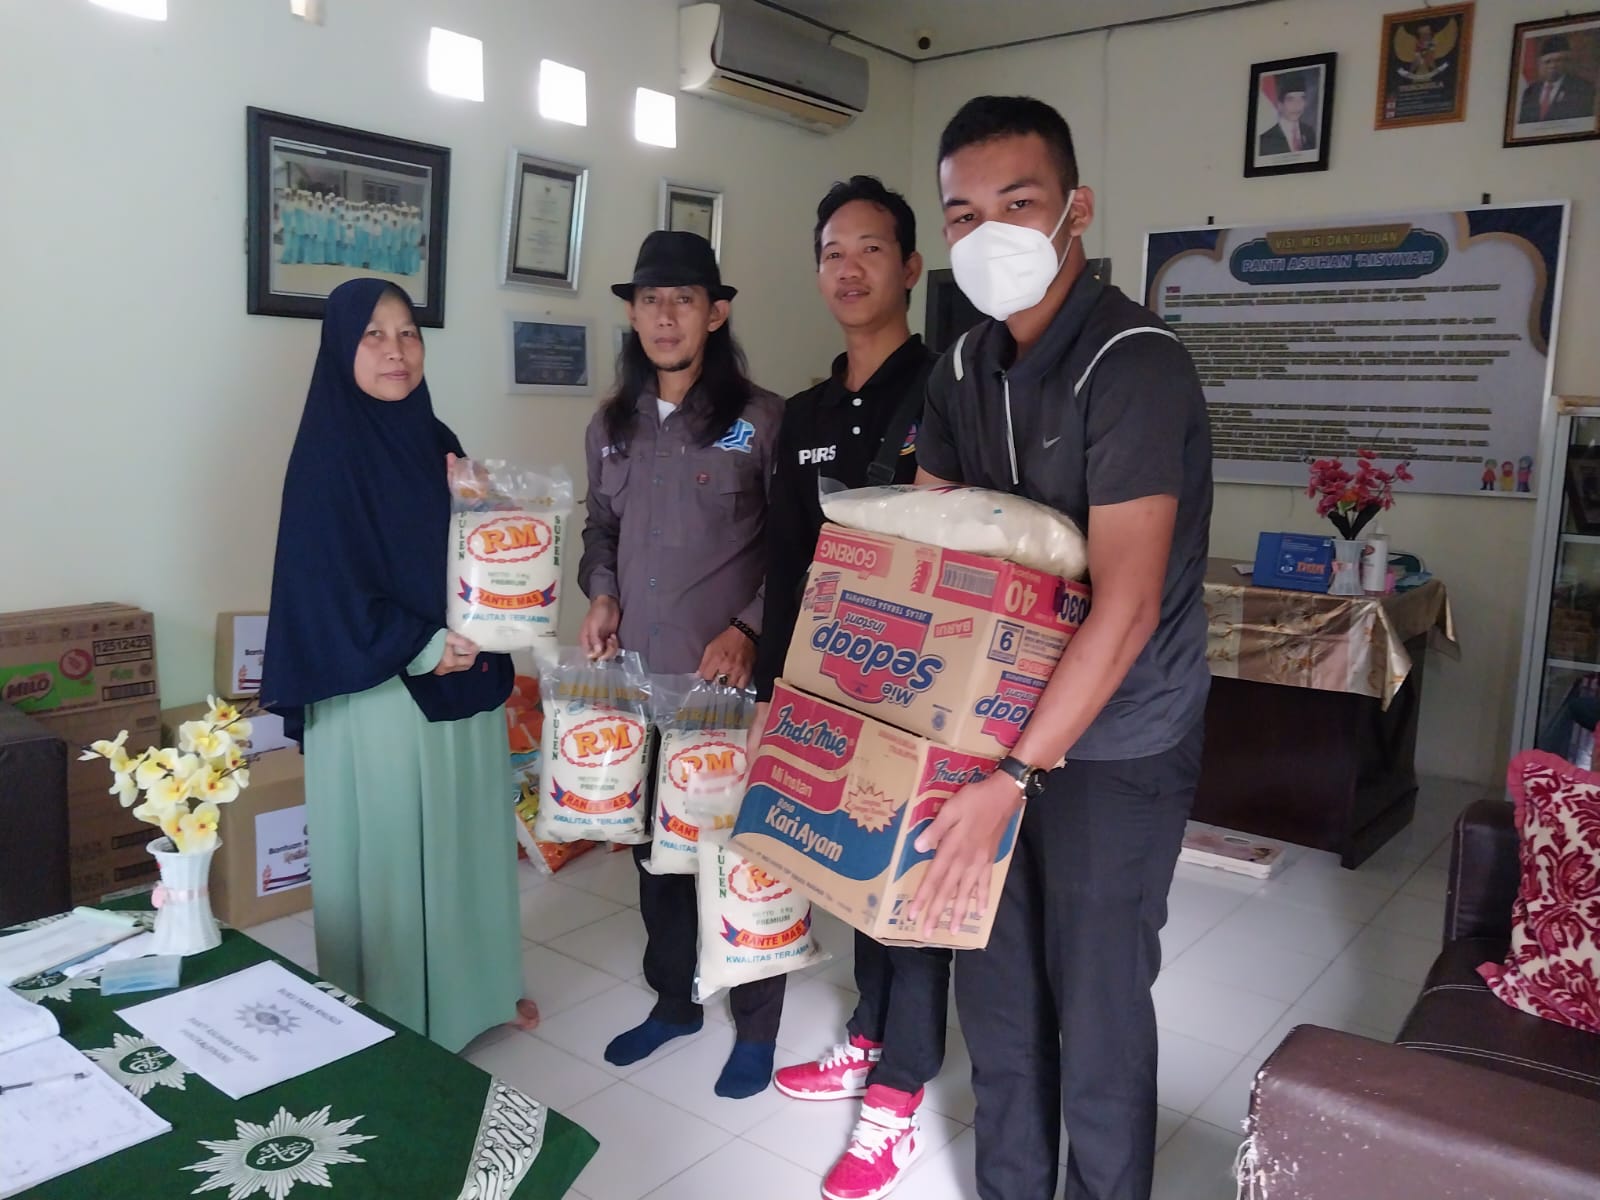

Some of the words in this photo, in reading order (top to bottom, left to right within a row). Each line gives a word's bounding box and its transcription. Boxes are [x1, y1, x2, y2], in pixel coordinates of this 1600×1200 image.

[1327, 233, 1350, 246] DAN
[1242, 258, 1286, 273] PANTI
[1287, 254, 1350, 271] ASUHAN
[479, 524, 541, 555] RM
[820, 539, 877, 568] GORENG
[517, 594, 540, 604] MAS
[1004, 581, 1038, 615] 40
[842, 611, 886, 634] Instant
[1000, 630, 1014, 651] 9
[813, 621, 943, 690] Sedaap
[7, 678, 50, 698] MILO
[882, 682, 915, 706] Mie
[573, 724, 633, 759] RM
[771, 765, 783, 781] Mi
[765, 805, 800, 837] Kari
[797, 820, 843, 863] Ayam
[741, 933, 778, 946] RANTE
[781, 926, 802, 943] MAS
[726, 954, 772, 963] KWALITAS
